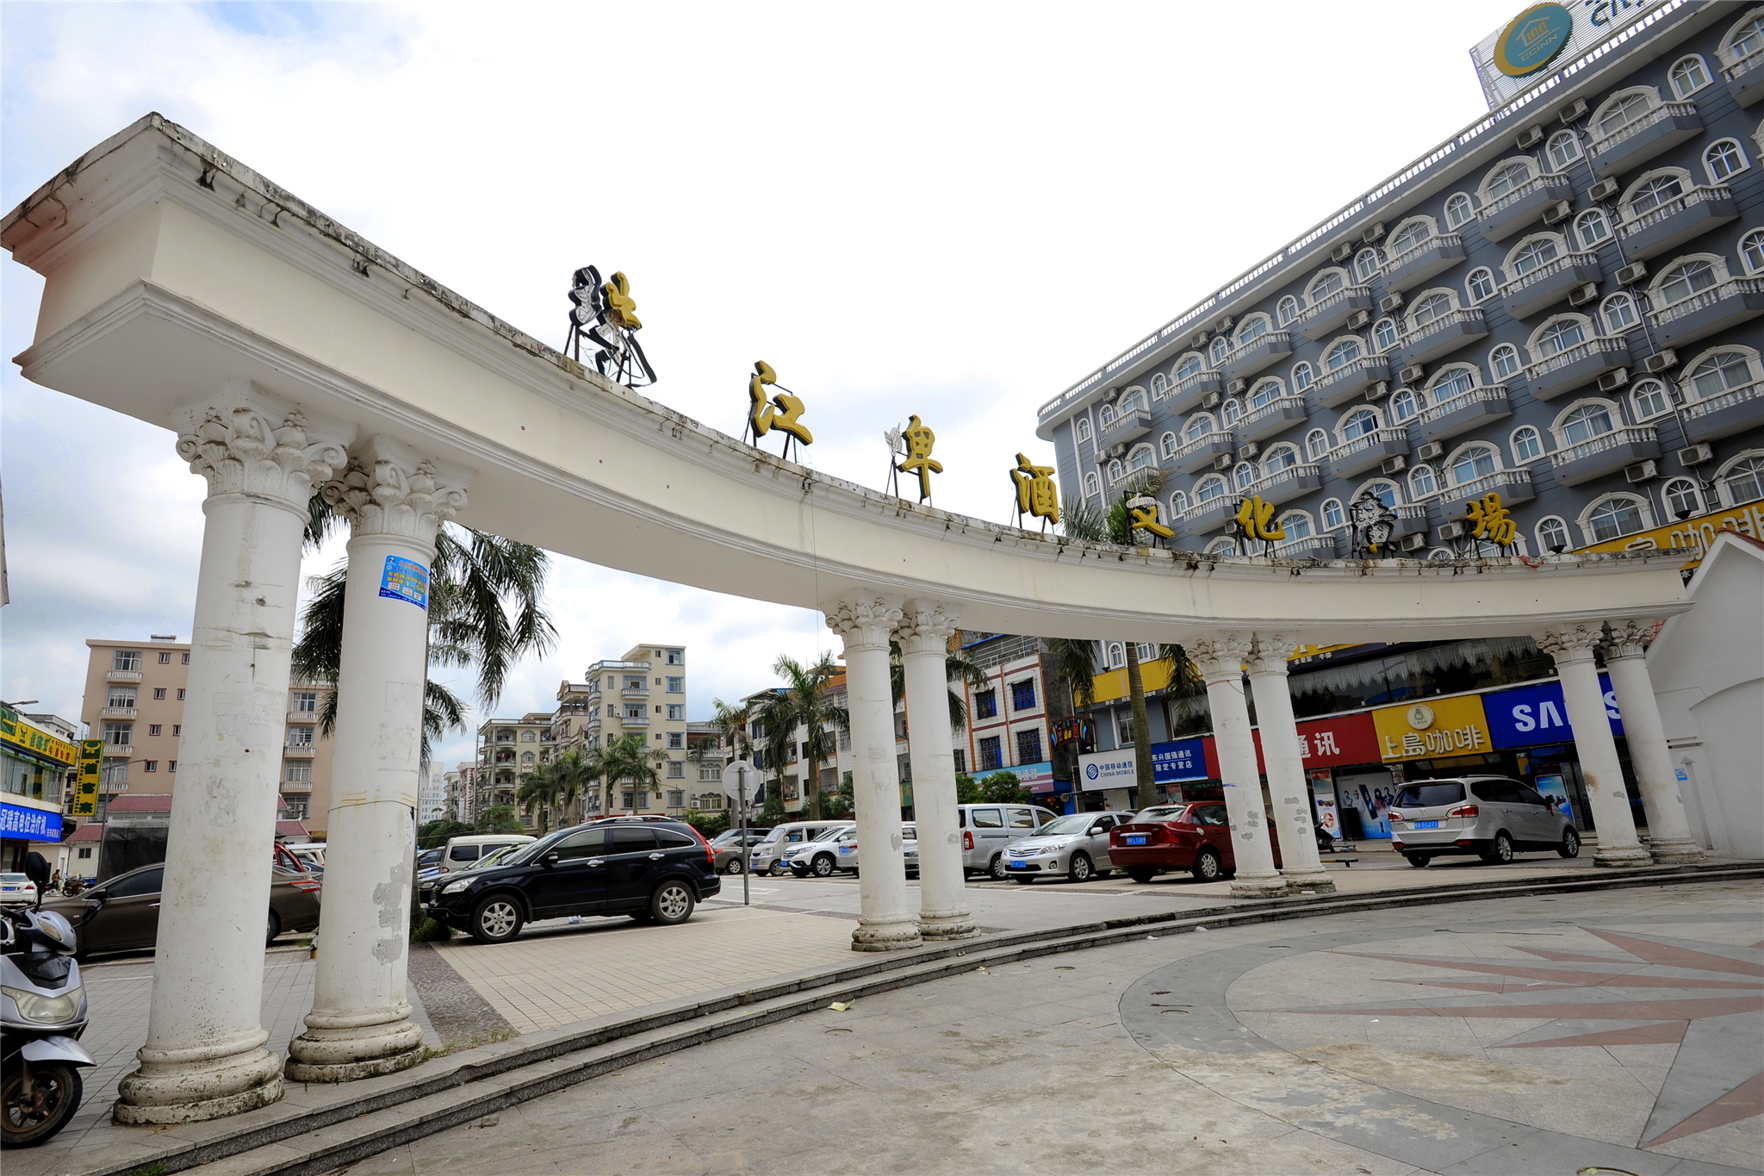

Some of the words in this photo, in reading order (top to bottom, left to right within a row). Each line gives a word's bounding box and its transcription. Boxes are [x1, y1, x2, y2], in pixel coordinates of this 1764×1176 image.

[1521, 33, 1558, 62] CCINN
[1099, 760, 1133, 772] 中国移动通信
[1155, 760, 1193, 772] 指定专营店
[1116, 769, 1135, 777] MOBILE
